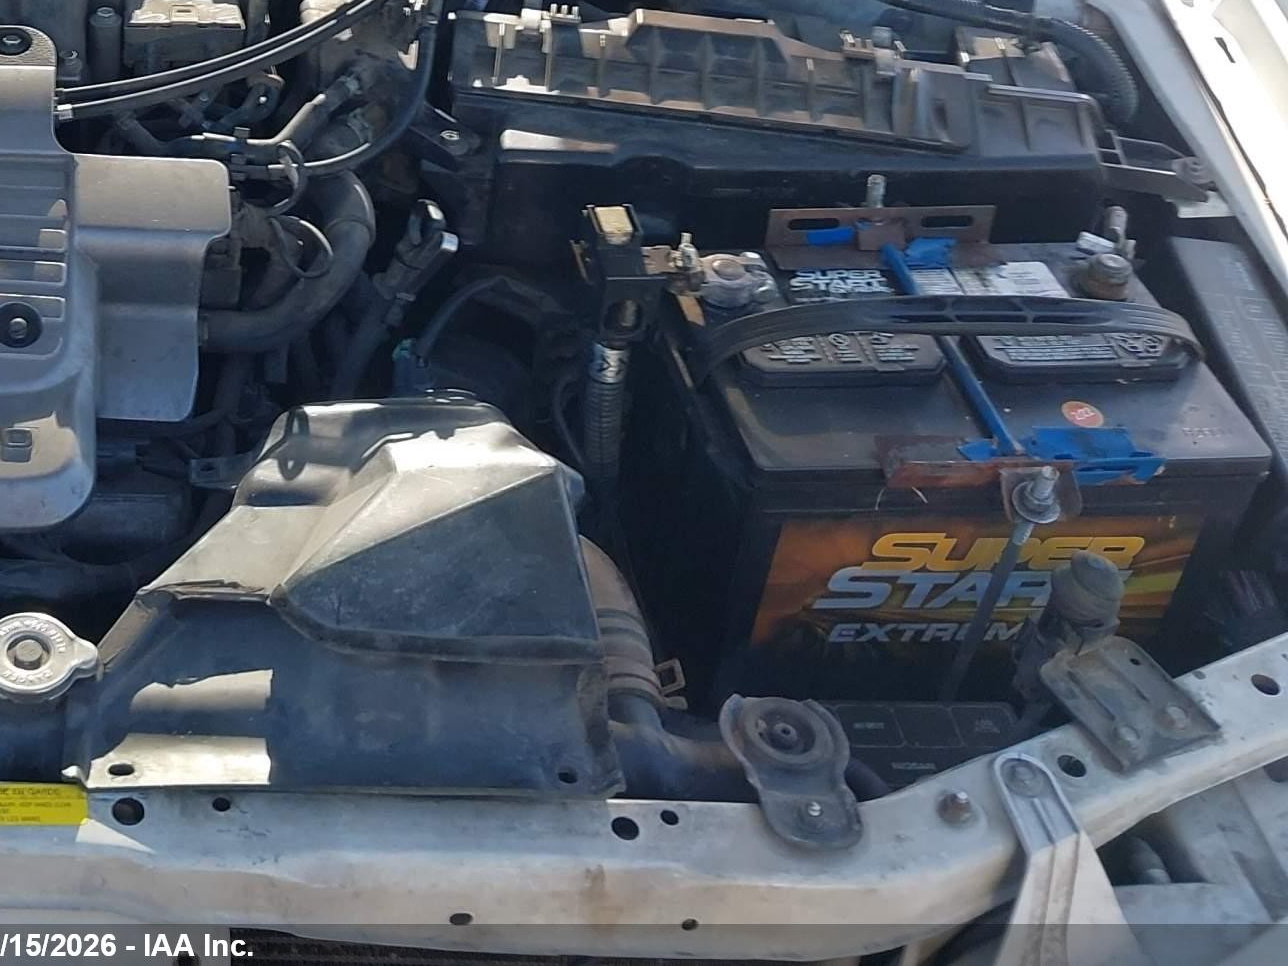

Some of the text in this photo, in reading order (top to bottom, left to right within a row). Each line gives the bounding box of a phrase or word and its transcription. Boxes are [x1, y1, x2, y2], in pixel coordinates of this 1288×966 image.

[789, 278, 887, 291] START
[795, 269, 881, 280] SUPER
[862, 532, 1145, 572] SUPER
[811, 566, 1133, 610] STAR
[828, 622, 1026, 644] EXTRM
